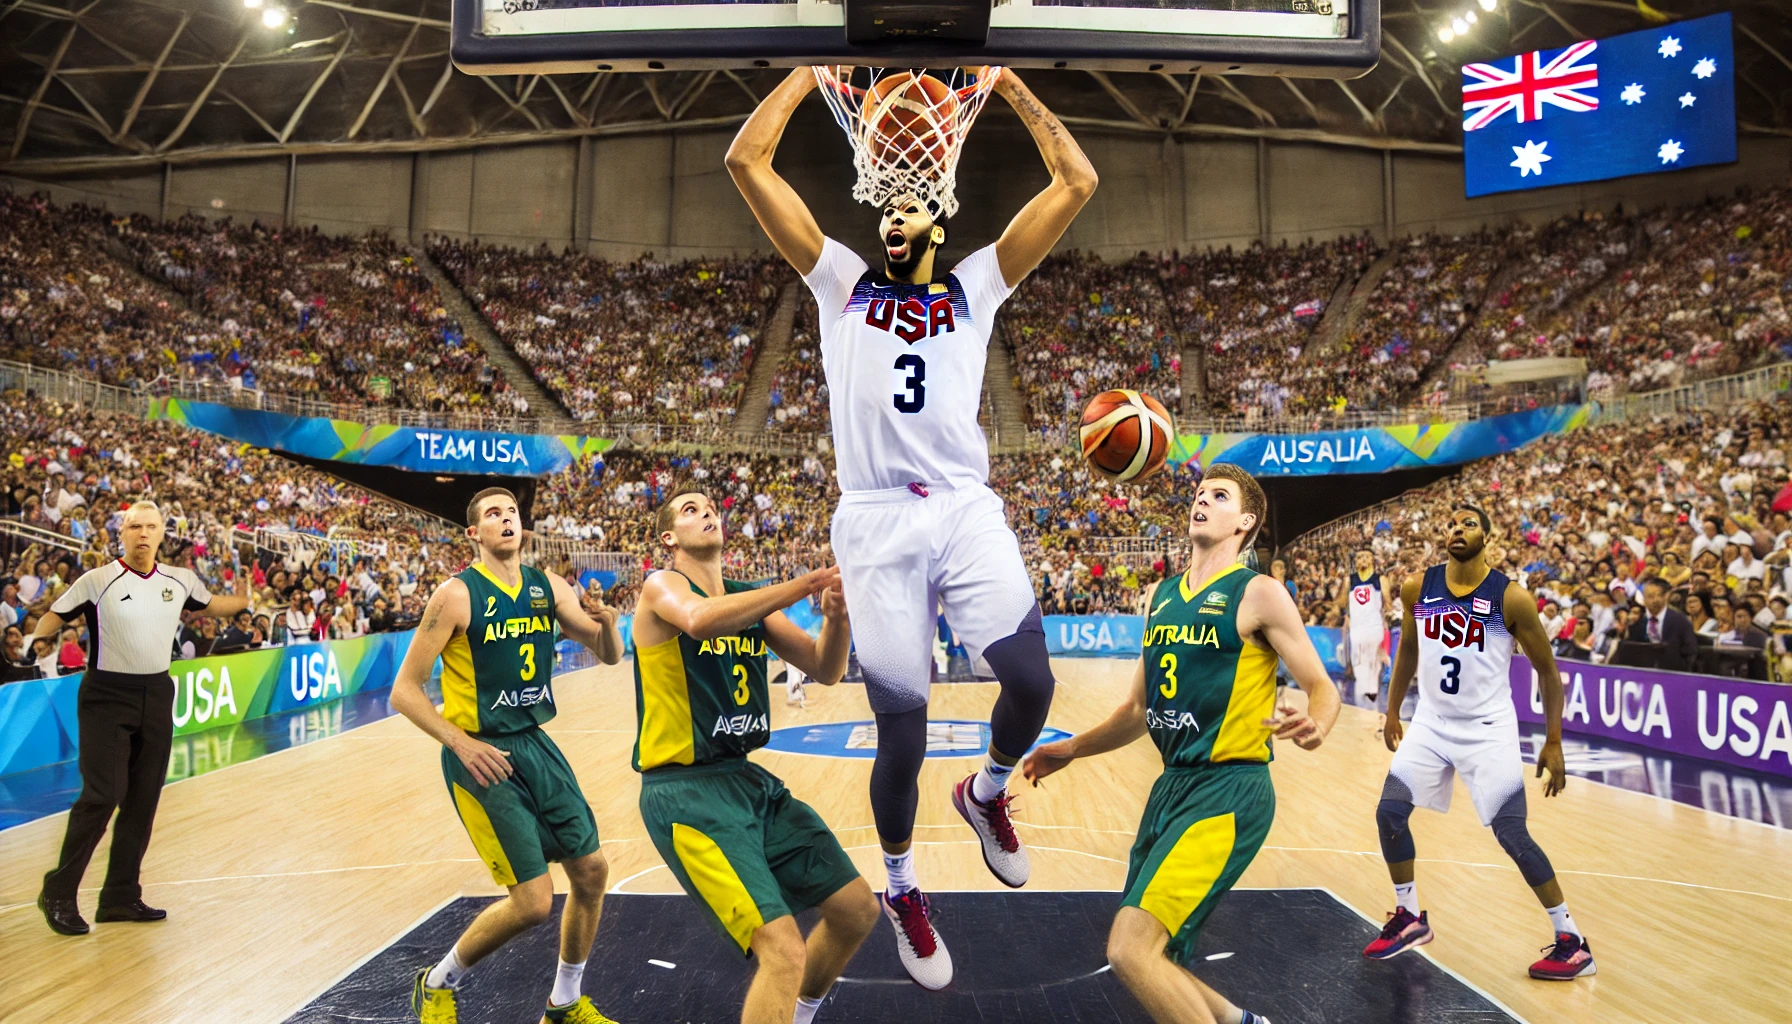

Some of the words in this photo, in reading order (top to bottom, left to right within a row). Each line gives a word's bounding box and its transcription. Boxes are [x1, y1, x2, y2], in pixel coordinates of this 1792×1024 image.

[866, 298, 955, 345] USA
[893, 353, 926, 413] 3
[415, 432, 476, 461] TEAM
[481, 437, 529, 466] USA
[1259, 435, 1376, 466] AUSALIA
[1060, 621, 1115, 650] USA
[1424, 611, 1485, 652] USA
[291, 648, 342, 701] USA
[519, 643, 536, 681] 3
[1159, 652, 1178, 699] 3
[1440, 655, 1461, 694] 3
[172, 665, 238, 728] USA
[732, 664, 750, 706] 3
[1697, 689, 1792, 767] USA
